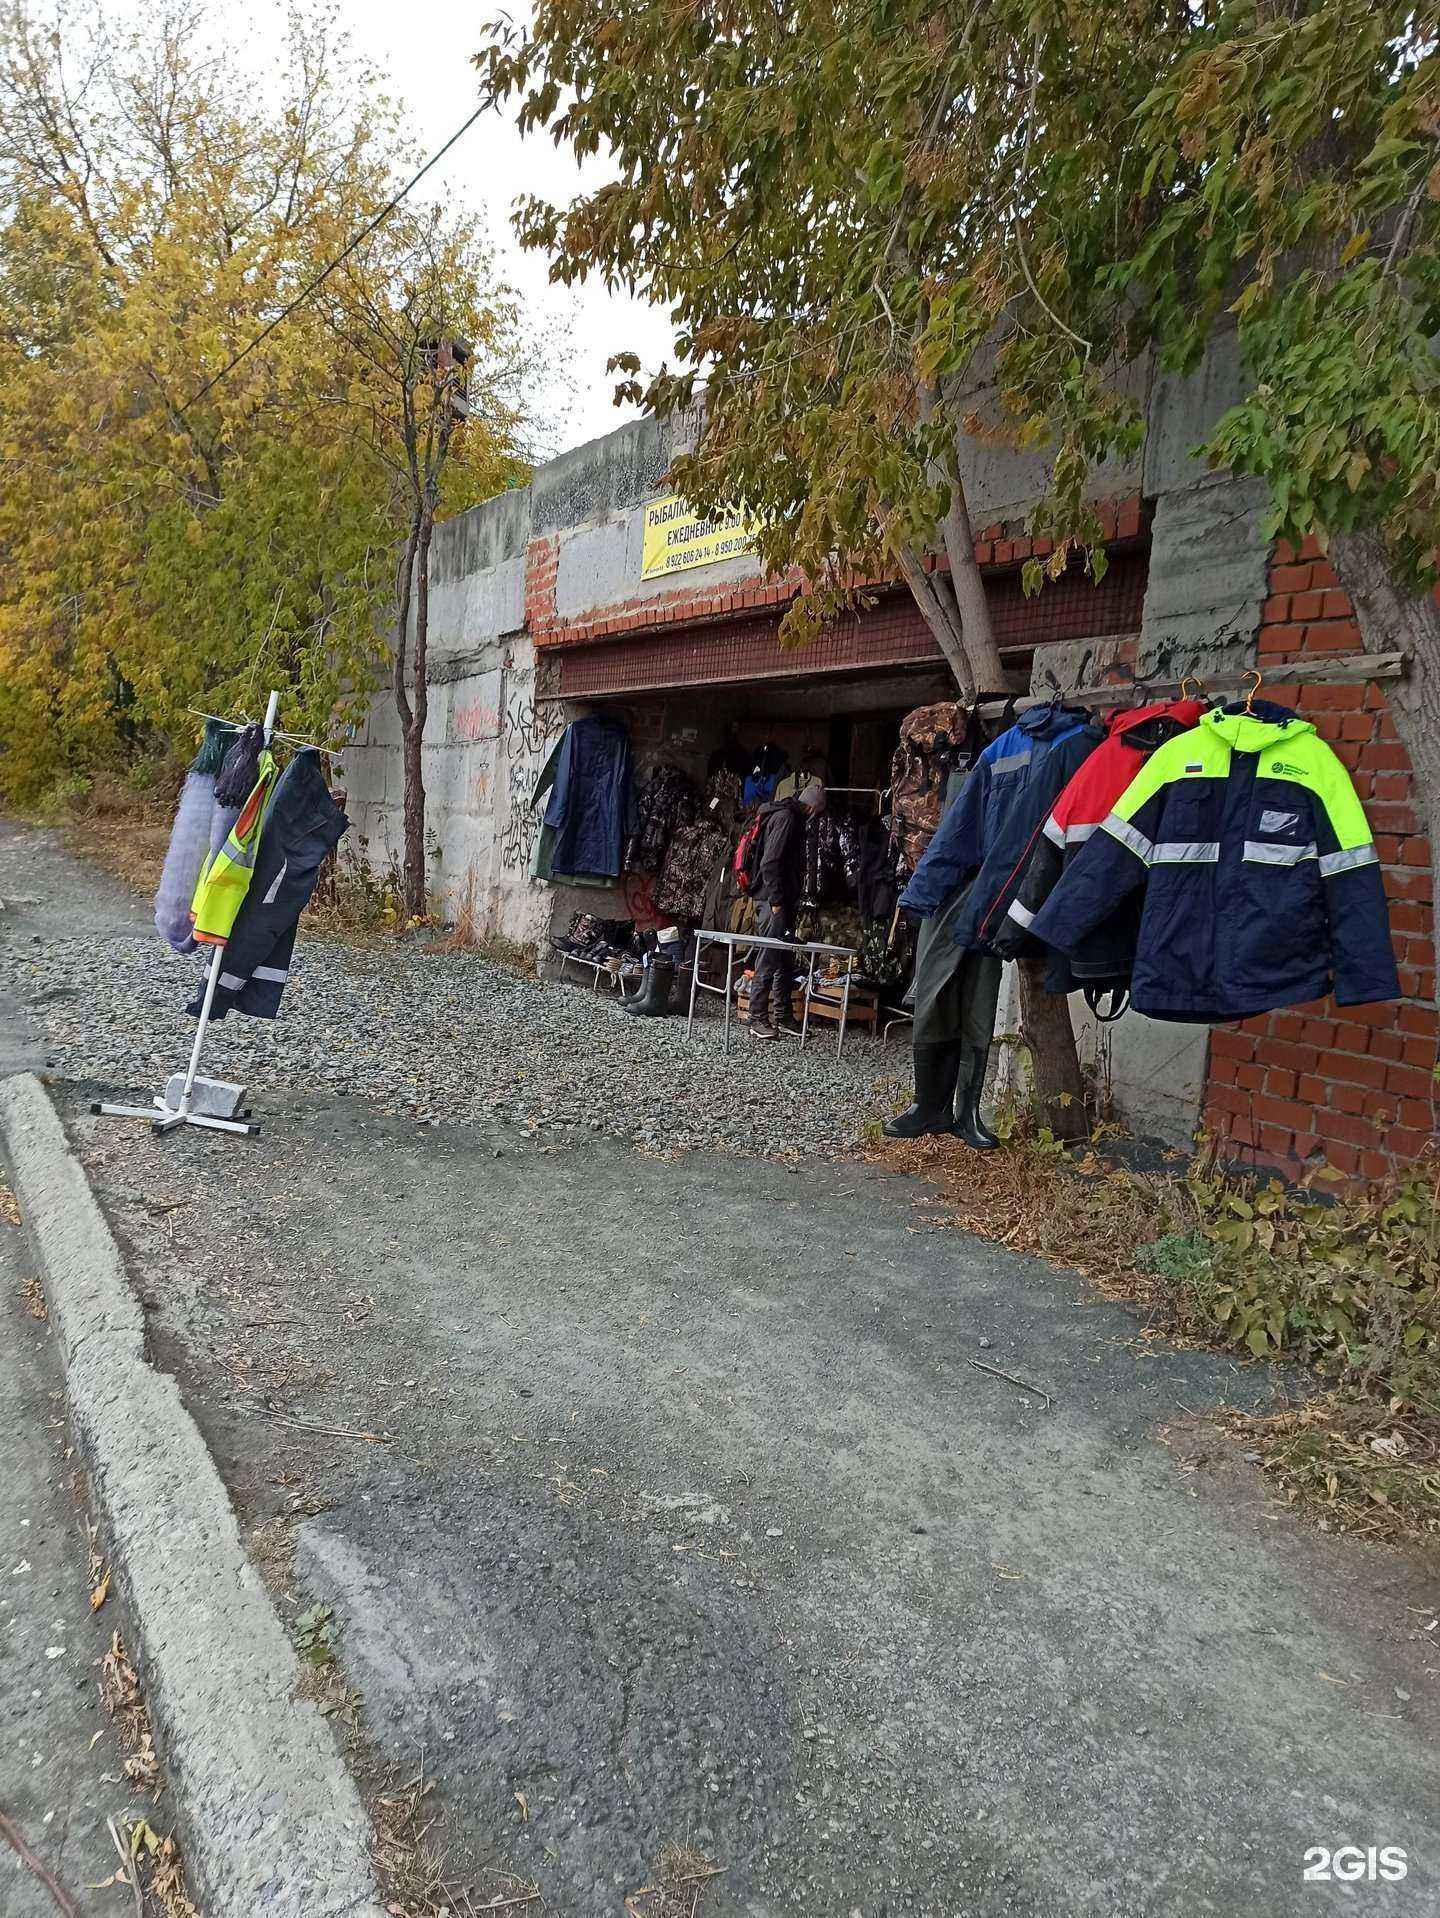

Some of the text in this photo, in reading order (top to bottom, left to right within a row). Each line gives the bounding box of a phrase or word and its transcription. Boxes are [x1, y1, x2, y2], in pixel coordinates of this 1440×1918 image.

[667, 517, 716, 546] ЕЖЕДНЕВНО
[665, 555, 671, 568] 8
[671, 552, 683, 567] 922
[714, 542, 720, 556] 8
